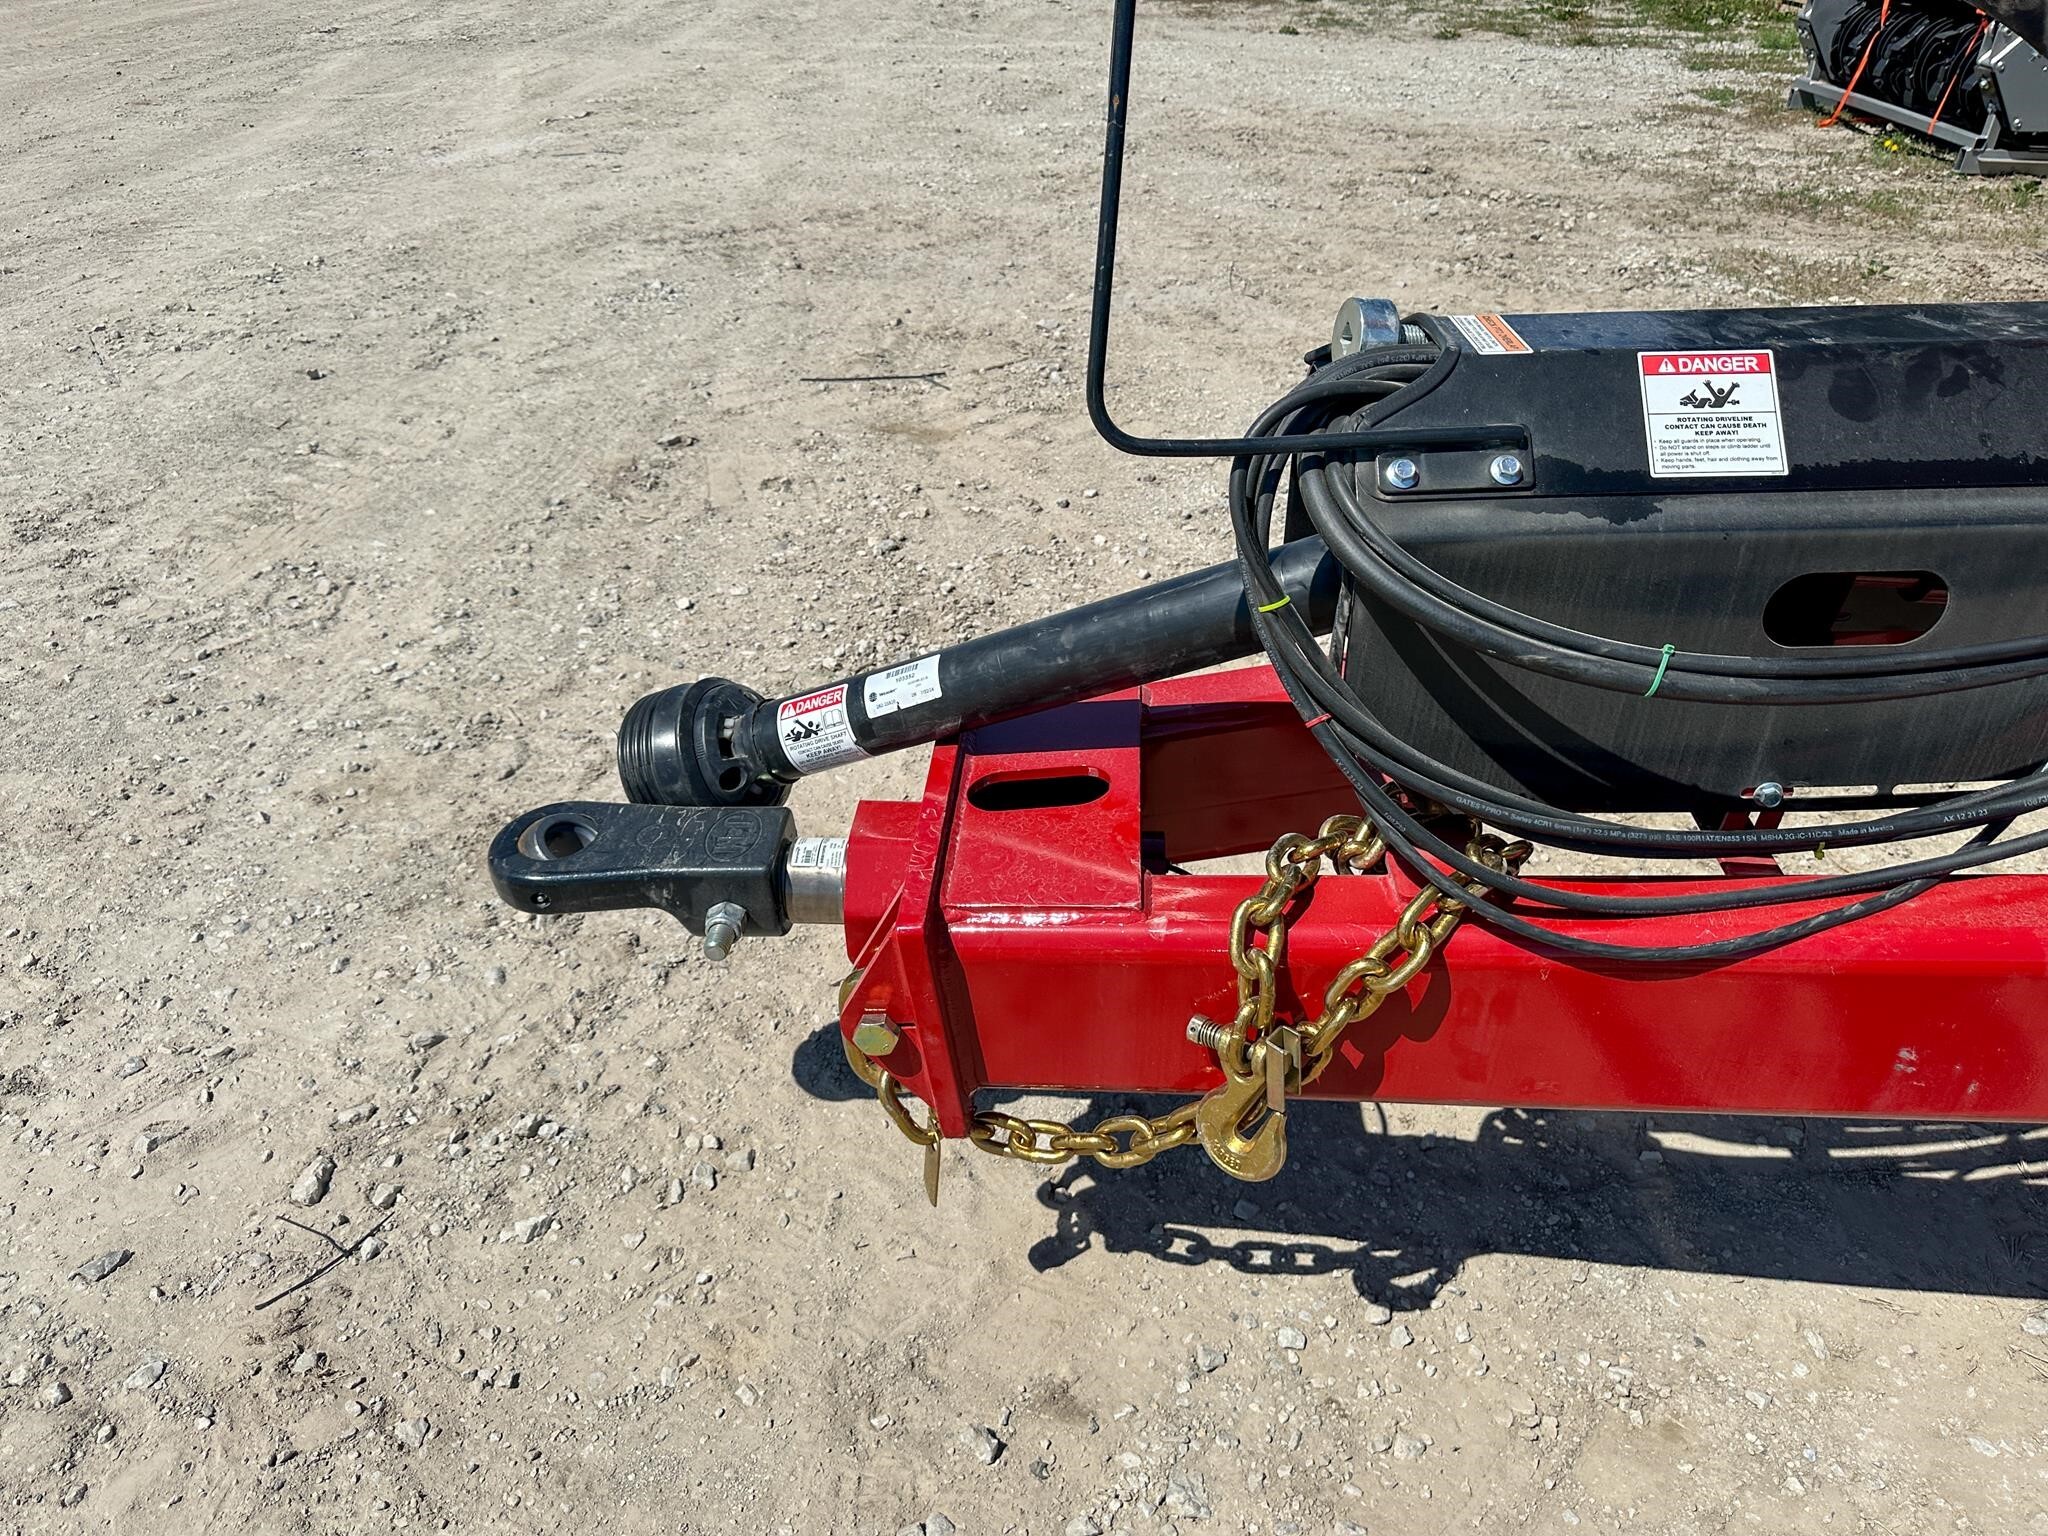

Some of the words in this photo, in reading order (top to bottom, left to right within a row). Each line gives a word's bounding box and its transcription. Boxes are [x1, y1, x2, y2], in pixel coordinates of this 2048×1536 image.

[1678, 356, 1760, 372] DANGER
[796, 690, 842, 714] DANGER
[789, 740, 814, 751] ROTATING
[814, 735, 830, 745] DRIVE
[831, 730, 847, 740] SHAFT
[805, 749, 823, 759] KEEP
[823, 744, 843, 755] AWAY!
[1943, 815, 1955, 823] AX
[1967, 811, 1976, 819] 21
[1979, 808, 1988, 817] 23
[1510, 812, 1532, 825] Series
[1760, 834, 1783, 842] MSHA
[1838, 827, 1859, 837] Made
[1859, 827, 1867, 835] in
[1868, 823, 1895, 834] Mexico
